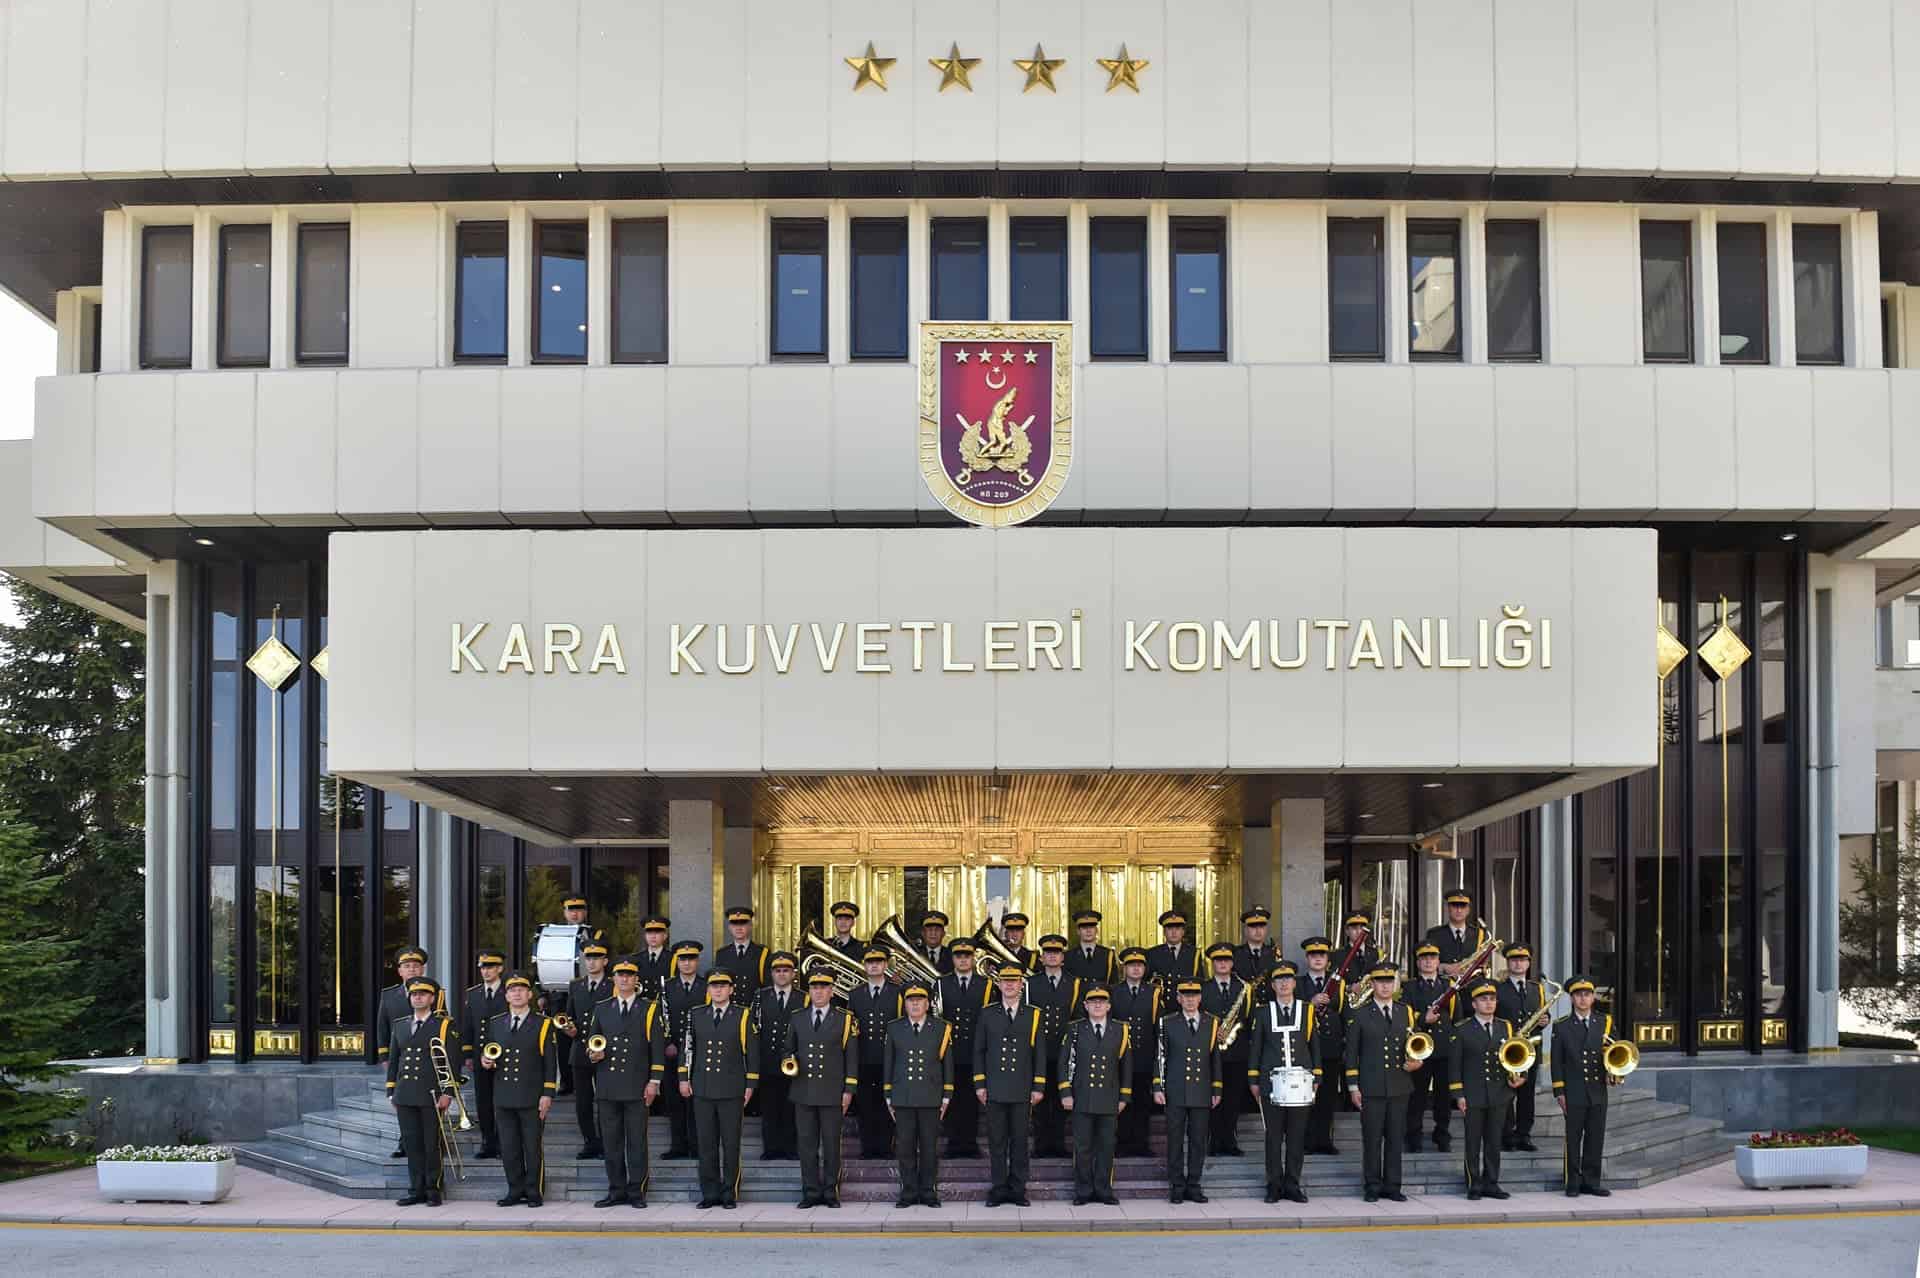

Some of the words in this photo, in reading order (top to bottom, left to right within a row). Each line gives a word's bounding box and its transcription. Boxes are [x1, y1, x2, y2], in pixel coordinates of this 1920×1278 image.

[450, 622, 627, 674] KARA
[669, 609, 1083, 674] KUVVETLERİ
[1124, 604, 1552, 670] KOMUTANLIĞI
